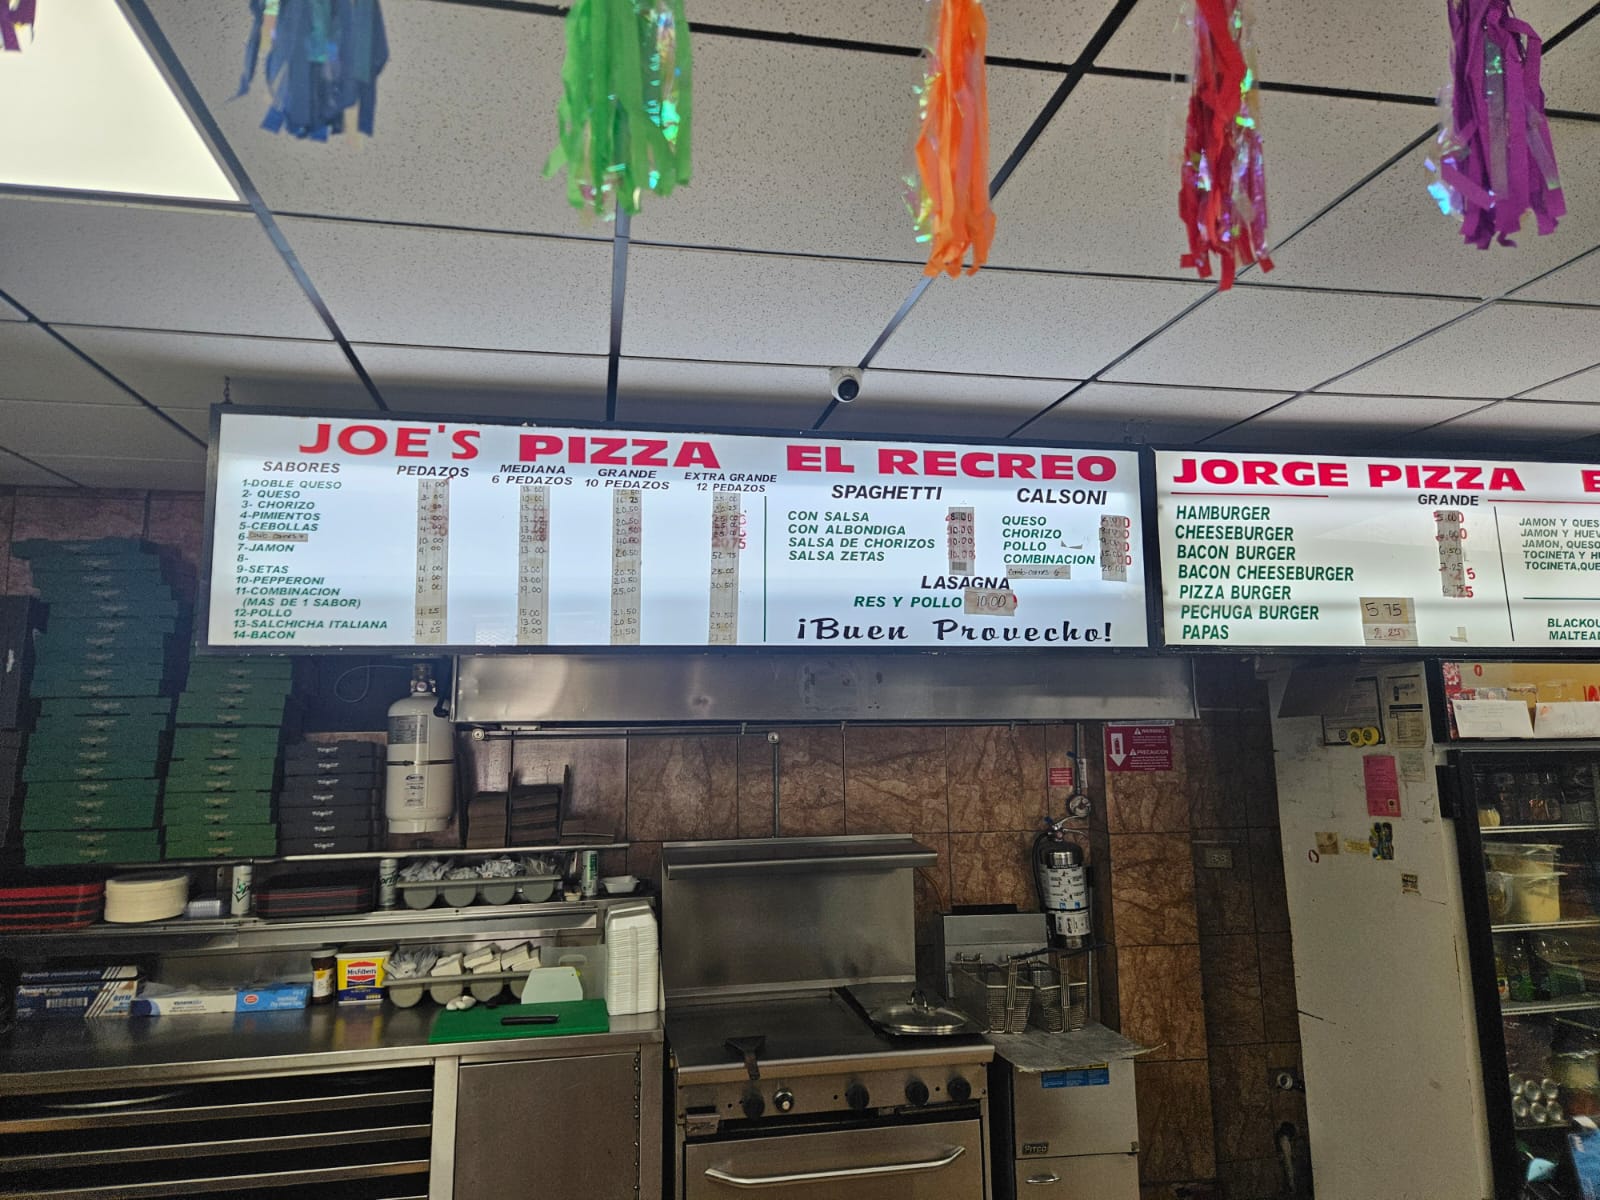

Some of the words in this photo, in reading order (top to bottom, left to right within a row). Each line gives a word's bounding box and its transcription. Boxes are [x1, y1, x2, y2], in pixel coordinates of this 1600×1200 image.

[299, 424, 480, 460] JOE'S
[518, 434, 721, 468] PIZZA
[786, 445, 855, 473] EL
[878, 448, 1117, 482] RECREO
[262, 461, 341, 474] SABORES
[396, 466, 470, 478] PEDAZOS
[500, 464, 566, 474] MEDIANA
[598, 468, 657, 478] GRANDE
[684, 472, 726, 480] EXTRA
[730, 474, 778, 482] GRANDE
[1173, 458, 1349, 487] JORGE
[1368, 464, 1526, 491] PIZZA
[242, 479, 294, 488] 1-DOBLE
[299, 480, 342, 490] QUESO
[492, 475, 500, 484] 6
[506, 476, 573, 486] PEDAZOS
[584, 479, 598, 487] 10
[605, 480, 670, 490] PEDAZOS
[697, 483, 708, 491] 12
[713, 483, 766, 492] PEDAZOS
[832, 484, 942, 500] SPAGHETTI
[257, 490, 301, 499] QUESO
[1017, 488, 1108, 505] CALSONI
[1418, 494, 1479, 506] GRANDE
[258, 501, 315, 510] CHORIZO
[240, 511, 321, 521] 4-PIMIENTOS
[788, 511, 818, 521] CON
[824, 512, 870, 522] SALSA
[1176, 506, 1270, 521] HAMBURGER
[1002, 516, 1047, 526] QUESO
[1519, 518, 1556, 526] JAMON
[239, 522, 319, 532] 5-CEBOLLAS
[788, 524, 818, 534] CON
[825, 525, 906, 535] ALBONDIGA
[1002, 528, 1062, 539] CHORIZO
[1175, 525, 1294, 541] CHEESEBURGER
[1521, 529, 1558, 537] JAMON
[237, 543, 295, 552] 7-JAMON
[788, 537, 834, 548] SALSA
[840, 538, 858, 548] DE
[864, 538, 935, 549] CHORIZOS
[1003, 541, 1046, 551] POLLO
[1522, 540, 1563, 549] JAMON,
[1566, 540, 1600, 549] QUESO
[237, 554, 249, 562] 8-
[788, 550, 834, 560] SALSA
[840, 551, 885, 561] ZETAS
[1177, 545, 1229, 559] BACON
[1236, 546, 1296, 561] BURGER
[1523, 550, 1575, 559] TOCINETA
[1579, 551, 1585, 559] Y
[1003, 554, 1096, 565] COMBINACION
[236, 565, 289, 574] 9-SETAS
[1178, 565, 1230, 579] BACON
[1236, 566, 1354, 581] CHEESEBURGER
[236, 576, 325, 585] 10-PEPPERONI
[920, 575, 1010, 590] LASAGNA
[235, 587, 341, 596] 11-COMBINACION
[1180, 585, 1224, 599] PIZZA
[1231, 585, 1291, 600] BURGER
[243, 598, 275, 608] (MAS
[280, 598, 297, 606] DE
[303, 598, 309, 606] 1
[313, 598, 361, 609] SABOR)
[854, 596, 886, 608] RES
[892, 596, 903, 607] Y
[911, 596, 962, 608] POLLO
[234, 608, 292, 617] 12-POLLO
[1180, 605, 1253, 619] PECHUGA
[1259, 605, 1319, 620] BURGER
[1365, 602, 1402, 616] 5.75
[233, 620, 324, 629] 13-SALCHICHA
[329, 620, 388, 629] ITALIANA
[797, 617, 909, 642] ¡Buen
[933, 619, 1112, 642] Provecho!
[233, 630, 296, 639] 14-BACON
[1182, 624, 1229, 640] PAPAS
